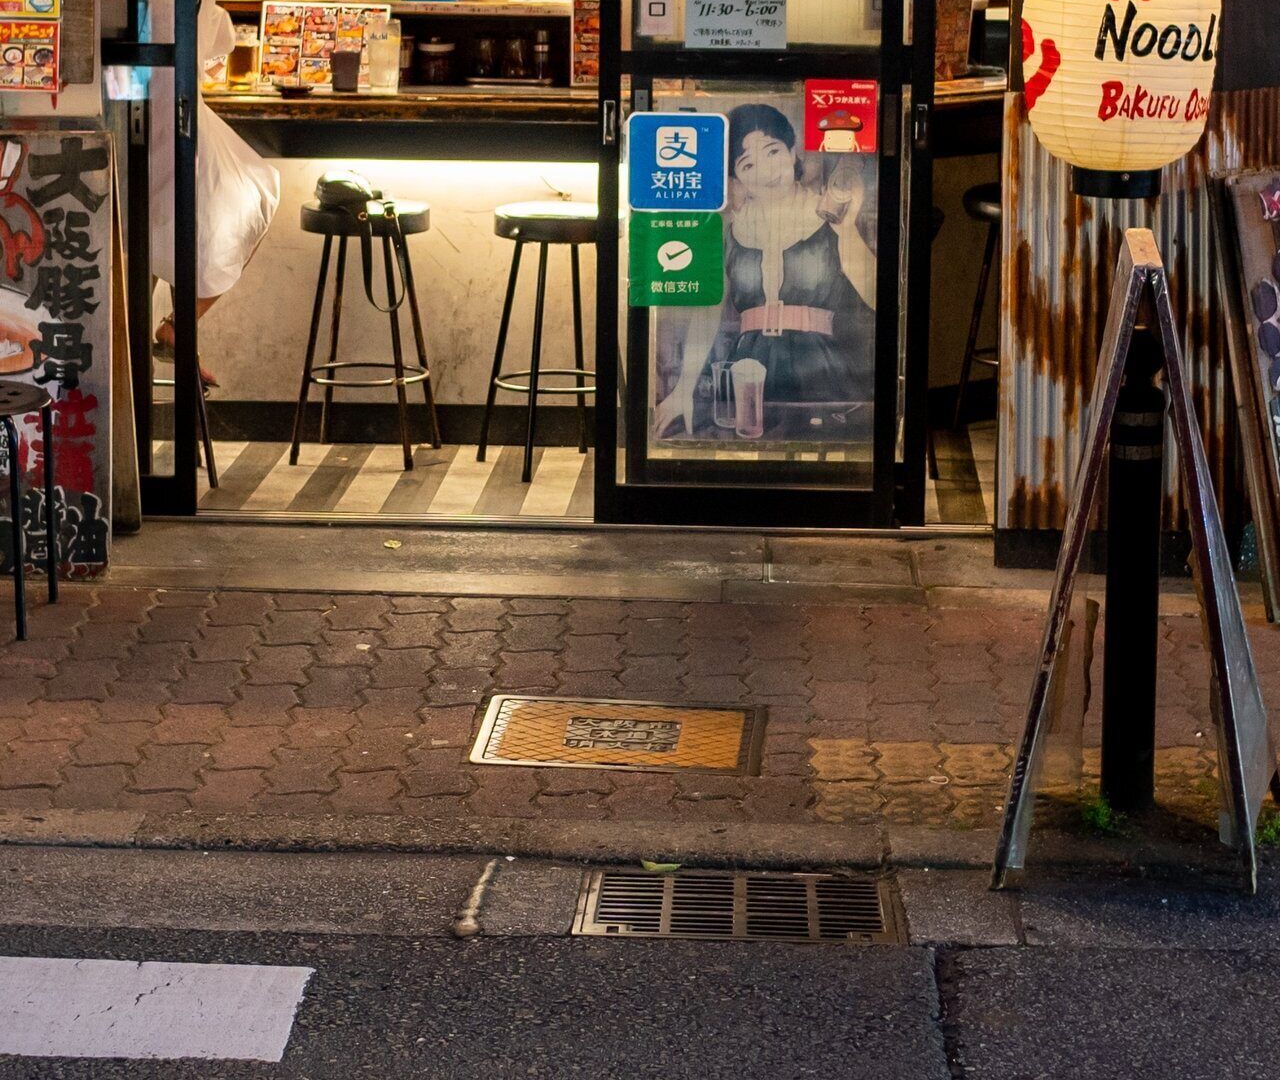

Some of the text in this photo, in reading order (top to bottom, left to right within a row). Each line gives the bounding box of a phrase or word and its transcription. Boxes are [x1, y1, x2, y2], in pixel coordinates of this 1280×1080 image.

[1097, 80, 1181, 122] BAKUFU
[650, 171, 702, 190] 支付宝
[655, 191, 698, 200] ALIPAY
[650, 280, 700, 294] 微信支付
